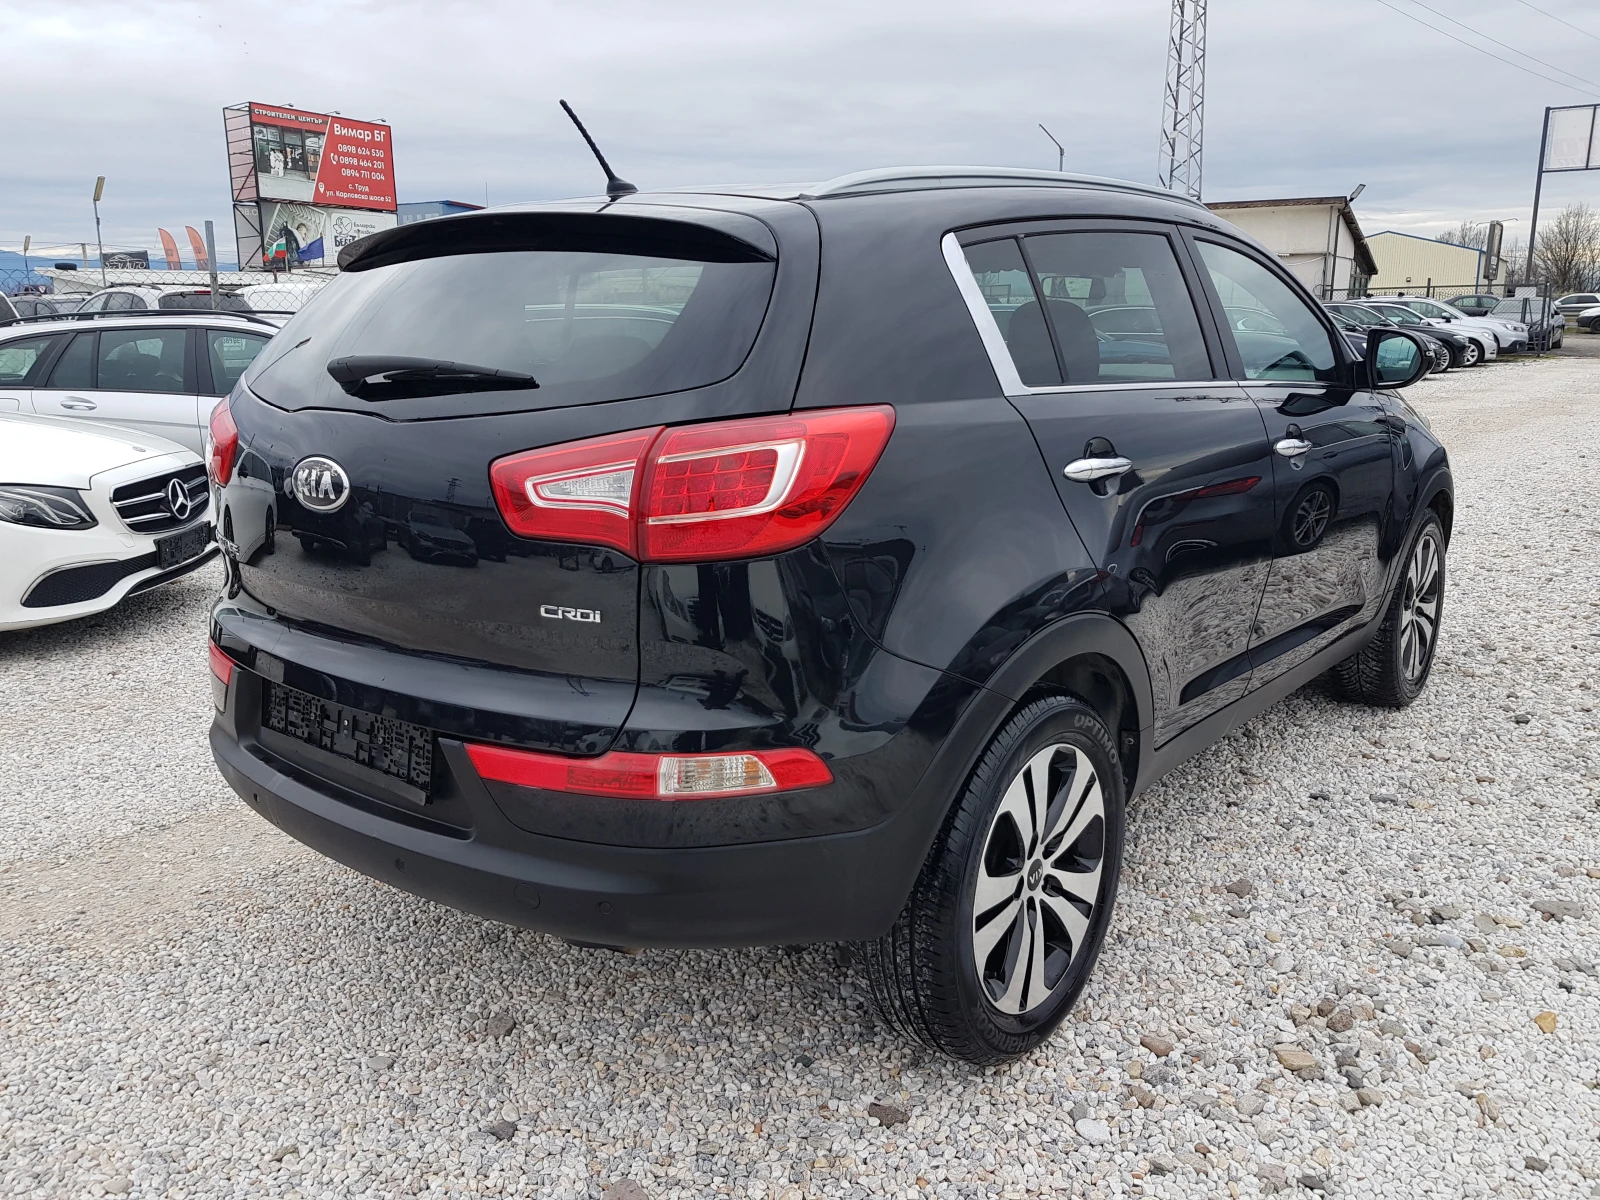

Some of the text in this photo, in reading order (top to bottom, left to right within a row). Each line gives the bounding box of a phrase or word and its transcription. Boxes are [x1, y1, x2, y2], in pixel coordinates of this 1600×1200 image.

[298, 115, 323, 124] ЦЕНТЪР
[333, 123, 386, 142] Вимар БГ
[337, 143, 384, 158] 0898 624 530
[339, 156, 385, 169] 0898 464 201
[341, 168, 385, 181] 0894 711 004
[354, 183, 369, 192] Труд
[297, 468, 337, 500] KIA
[1073, 713, 1118, 764] OPTIMO
